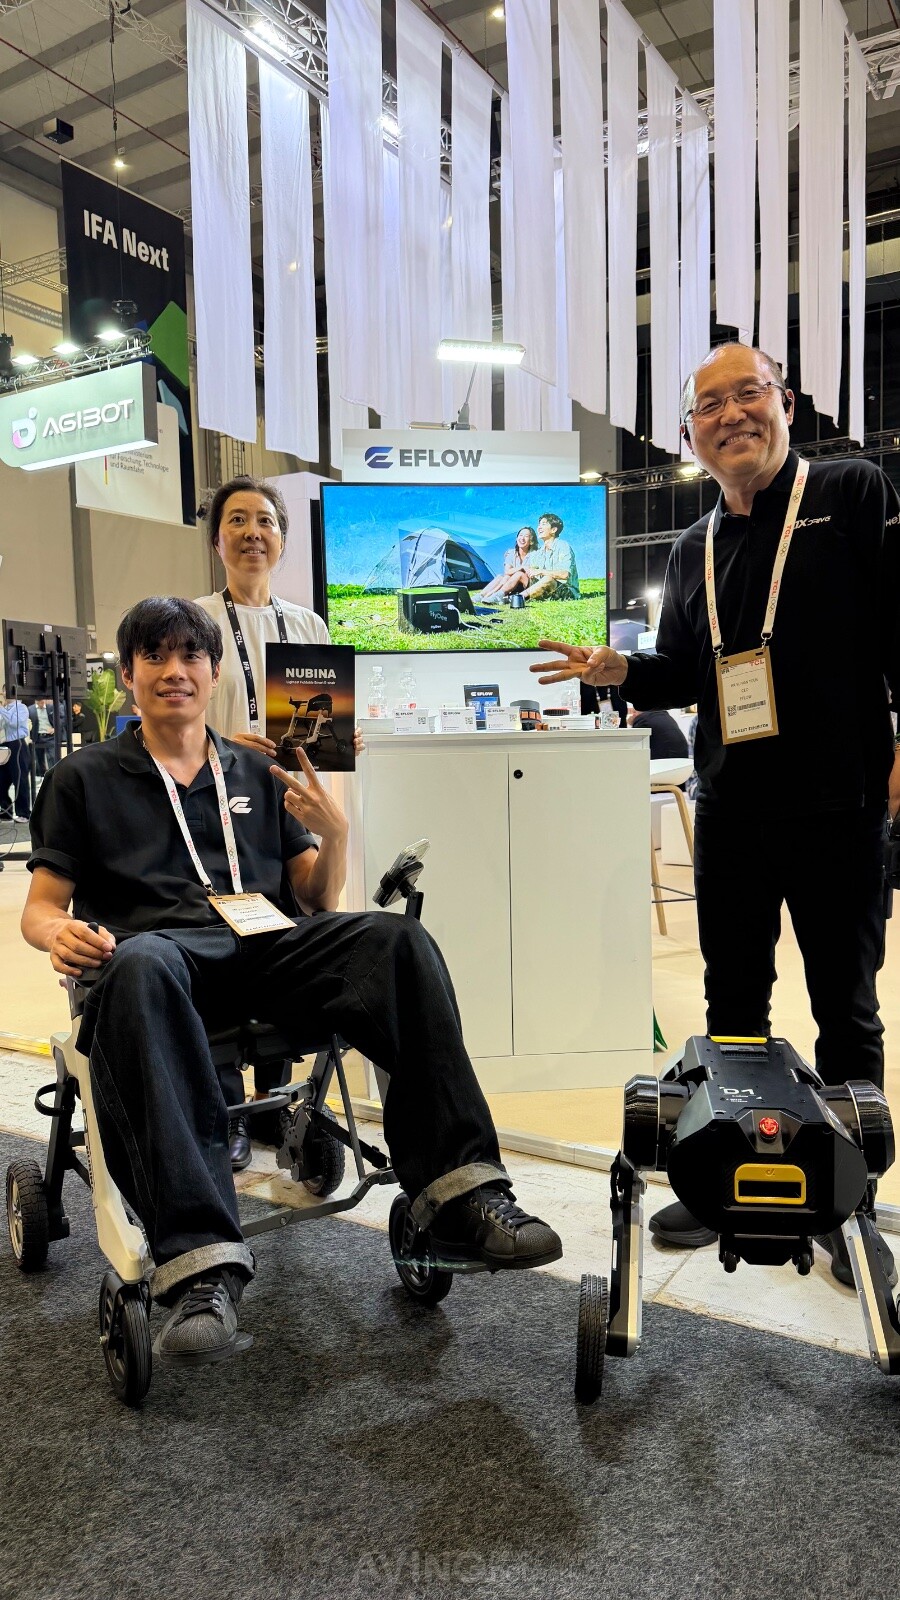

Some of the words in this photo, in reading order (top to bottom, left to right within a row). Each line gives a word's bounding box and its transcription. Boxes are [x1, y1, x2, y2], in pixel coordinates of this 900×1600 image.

[83, 209, 118, 249] IFA
[122, 227, 169, 272] Next
[42, 398, 134, 438] AGIBOT
[399, 449, 483, 467] EFLOW
[783, 524, 792, 540] TCL
[771, 580, 779, 596] TCL
[234, 629, 244, 646] TCL
[285, 667, 337, 679] NUBINA
[248, 697, 257, 715] TCL
[170, 788, 178, 804] TCL
